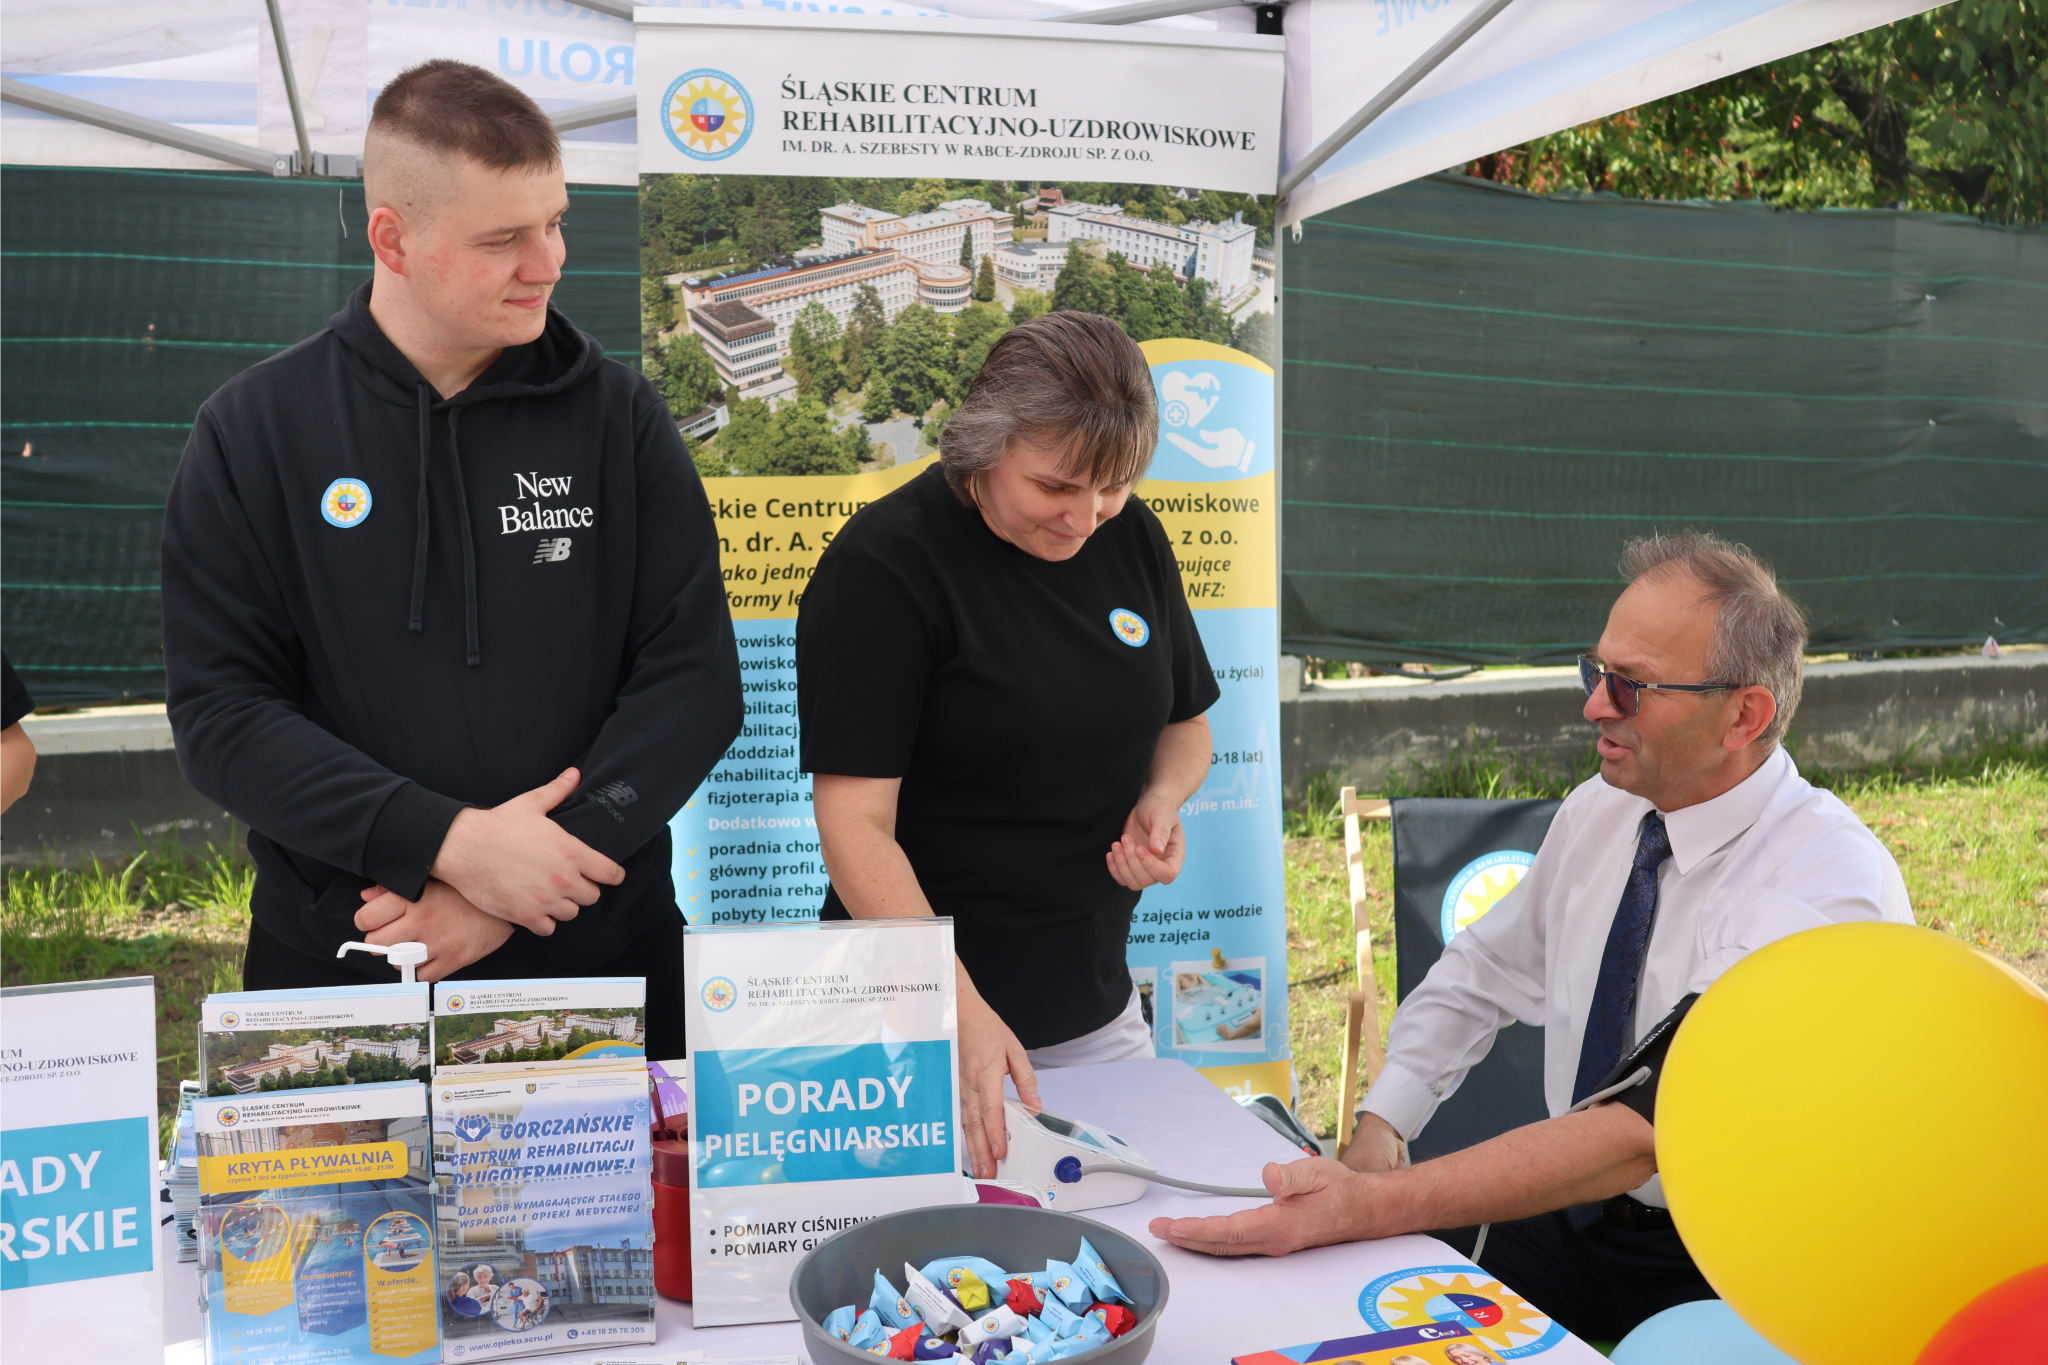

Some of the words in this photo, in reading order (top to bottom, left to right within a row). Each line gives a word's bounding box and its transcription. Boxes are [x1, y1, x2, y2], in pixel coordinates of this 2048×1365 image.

[781, 74, 896, 107] ŚLĄSKIE
[903, 84, 1038, 108] CENTRUM
[782, 110, 1256, 151] REHABILITACYJNO-UZDROWISKOWE
[782, 139, 807, 152] IM.
[811, 140, 837, 153] DR.
[842, 142, 856, 154] A.
[860, 141, 940, 155] SZEBESTY
[945, 143, 960, 155] W
[963, 144, 1083, 159] RABCE-ZDROJU
[1086, 147, 1107, 160] SP.
[1111, 148, 1121, 160] Z
[1124, 149, 1154, 162] O.O.
[513, 471, 573, 500] New
[498, 502, 594, 535] Balance
[746, 531, 781, 552] dr.
[789, 532, 813, 551] A.
[1182, 530, 1193, 545] z
[1199, 530, 1238, 545] o.o.
[1187, 582, 1226, 598] NFZ:
[1229, 665, 1264, 683] życia)
[739, 723, 800, 740] bilitacj
[1242, 750, 1263, 764] lat)
[707, 789, 799, 808] fizjoterapia
[708, 815, 801, 831] Dodatkowo
[709, 841, 781, 860] poradnia
[709, 864, 767, 882] główny
[772, 862, 815, 879] profil
[711, 884, 782, 903] poradnia
[711, 907, 767, 924] pobyty
[1142, 908, 1193, 925] zajęcia
[1198, 910, 1210, 920] w
[1214, 904, 1263, 919] wodzie
[1159, 929, 1210, 945] zajęcia
[747, 976, 793, 988] ŚLĄSKIE
[795, 974, 849, 985] CENTRUM
[748, 983, 941, 999] REHABILITACYJNO-UZDROWISKOWE
[738, 1075, 914, 1117] PORADY
[500, 1112, 635, 1140] GORCZAŃSKIE
[704, 1121, 946, 1162] PIELĘGNIARSKIE
[227, 1159, 285, 1176] KRYTA
[290, 1150, 394, 1170] PŁYWALNIA
[451, 1148, 521, 1167] CENTRUM
[526, 1140, 635, 1159] REHABILITACJI
[0, 1150, 102, 1197] ADY
[227, 1176, 252, 1184] czynna
[278, 1171, 308, 1180] tygodniu
[355, 1165, 372, 1173] 15:00
[514, 1195, 595, 1210] WYMAGAJĄCYCH
[598, 1192, 641, 1203] STAŁEGO
[459, 1215, 517, 1229] WSPARCIA
[531, 1209, 571, 1221] OPIEKI
[575, 1204, 641, 1217] MEDYCZNEJ
[724, 1221, 798, 1238] POMIARY
[801, 1216, 877, 1233] CIŚNIE
[724, 1239, 798, 1256] POMIARY
[301, 1270, 355, 1281] Honorujemy:
[377, 1279, 386, 1287] W
[387, 1277, 418, 1286] ofercie:
[580, 1328, 597, 1336] +48
[607, 1327, 619, 1335] 26
[631, 1326, 646, 1334] 305
[469, 1333, 553, 1353] www.opieka.scru.pl
